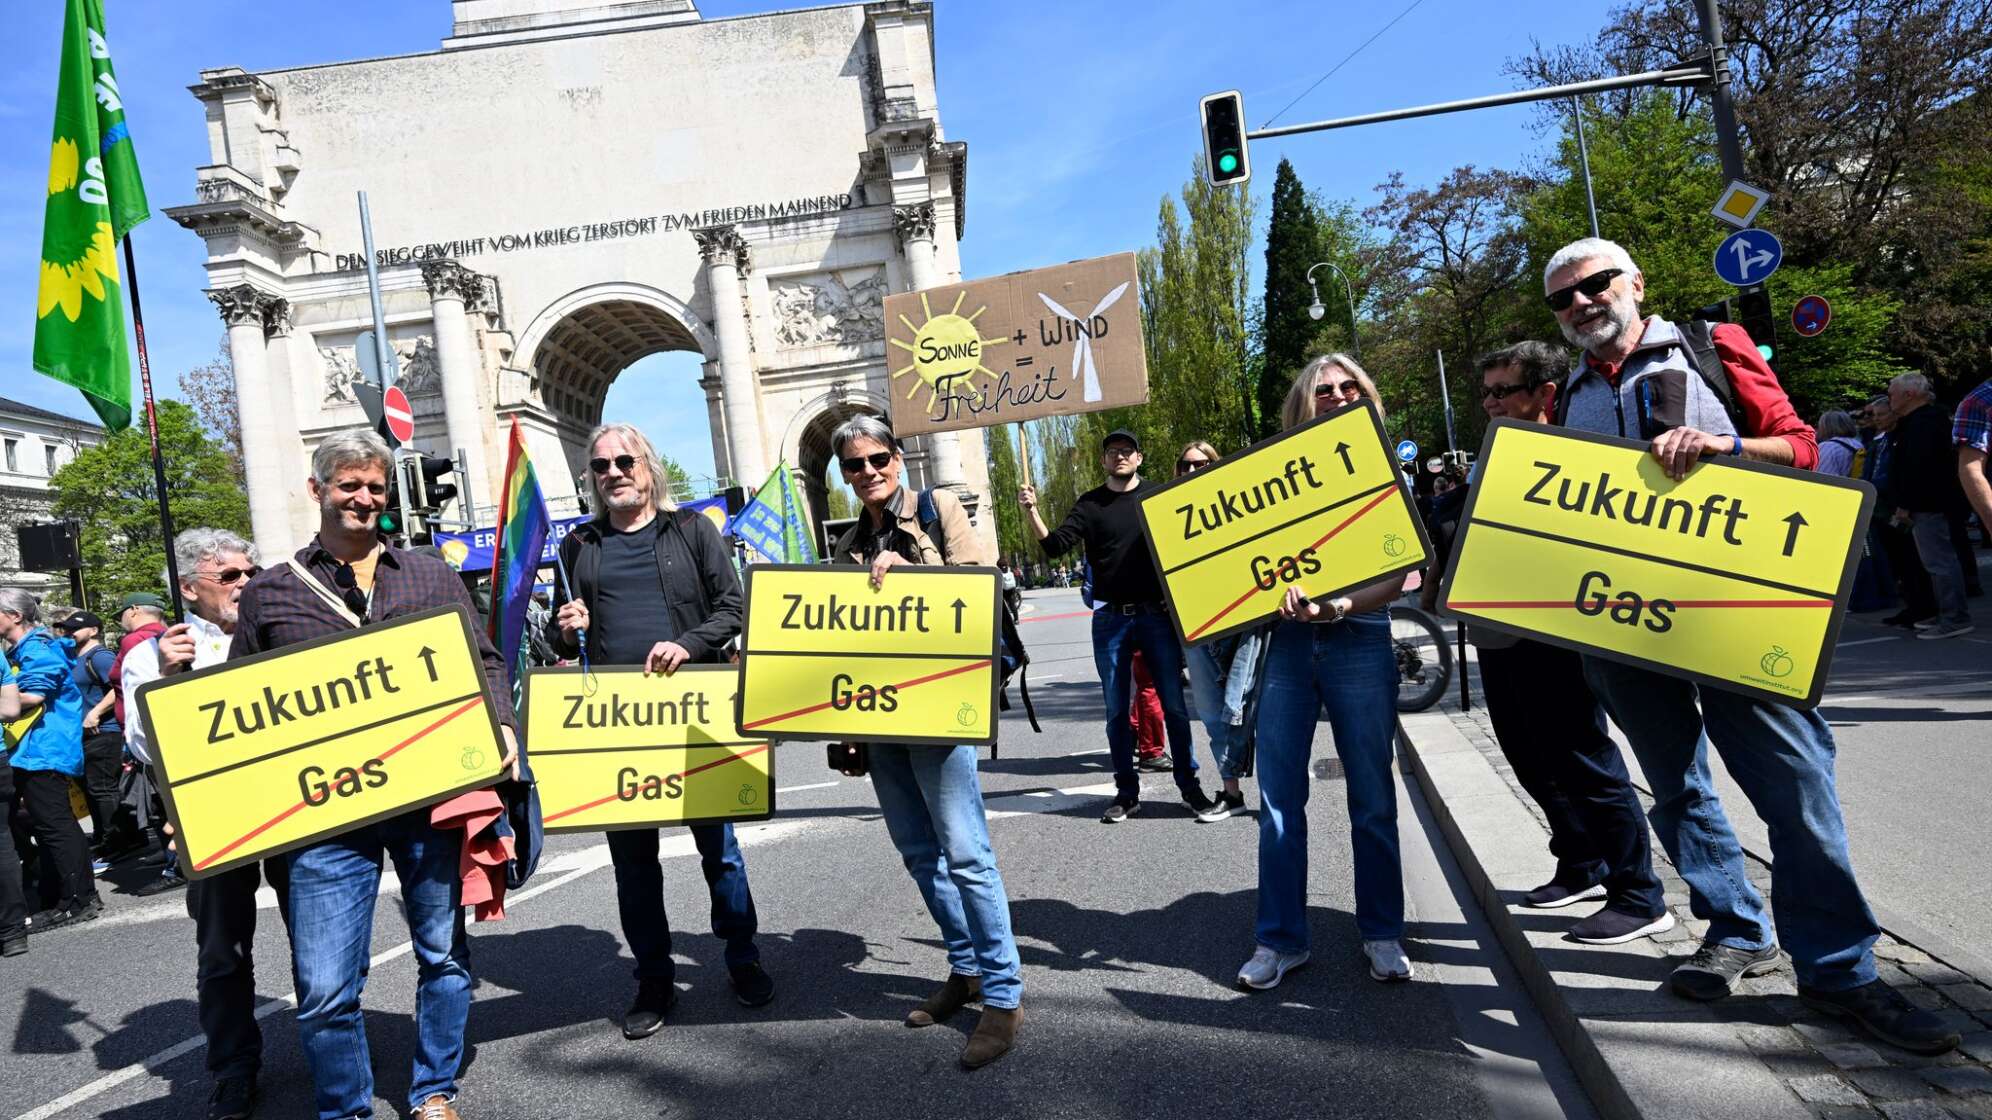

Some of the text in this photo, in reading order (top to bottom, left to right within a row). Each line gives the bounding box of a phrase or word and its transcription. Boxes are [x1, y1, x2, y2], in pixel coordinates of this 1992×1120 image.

[376, 246, 411, 265] SIEG
[412, 238, 485, 260] GEWEIHT
[488, 231, 532, 252] VOM
[534, 225, 581, 247] KRIEG
[702, 205, 766, 226] FRIEDEN
[768, 194, 852, 216] MAHNEND
[930, 366, 1067, 423] Freiheit
[1175, 456, 1324, 540] Zukunft
[1523, 460, 1749, 546] Zukunft
[1250, 548, 1322, 591] Gas
[781, 594, 930, 633] Zukunft
[1574, 570, 1677, 633] Gas
[198, 657, 401, 744] Zukunft
[562, 691, 711, 729] Zukunft
[831, 673, 898, 712] Gas
[297, 758, 389, 807] Gas
[617, 767, 684, 802] Gas
